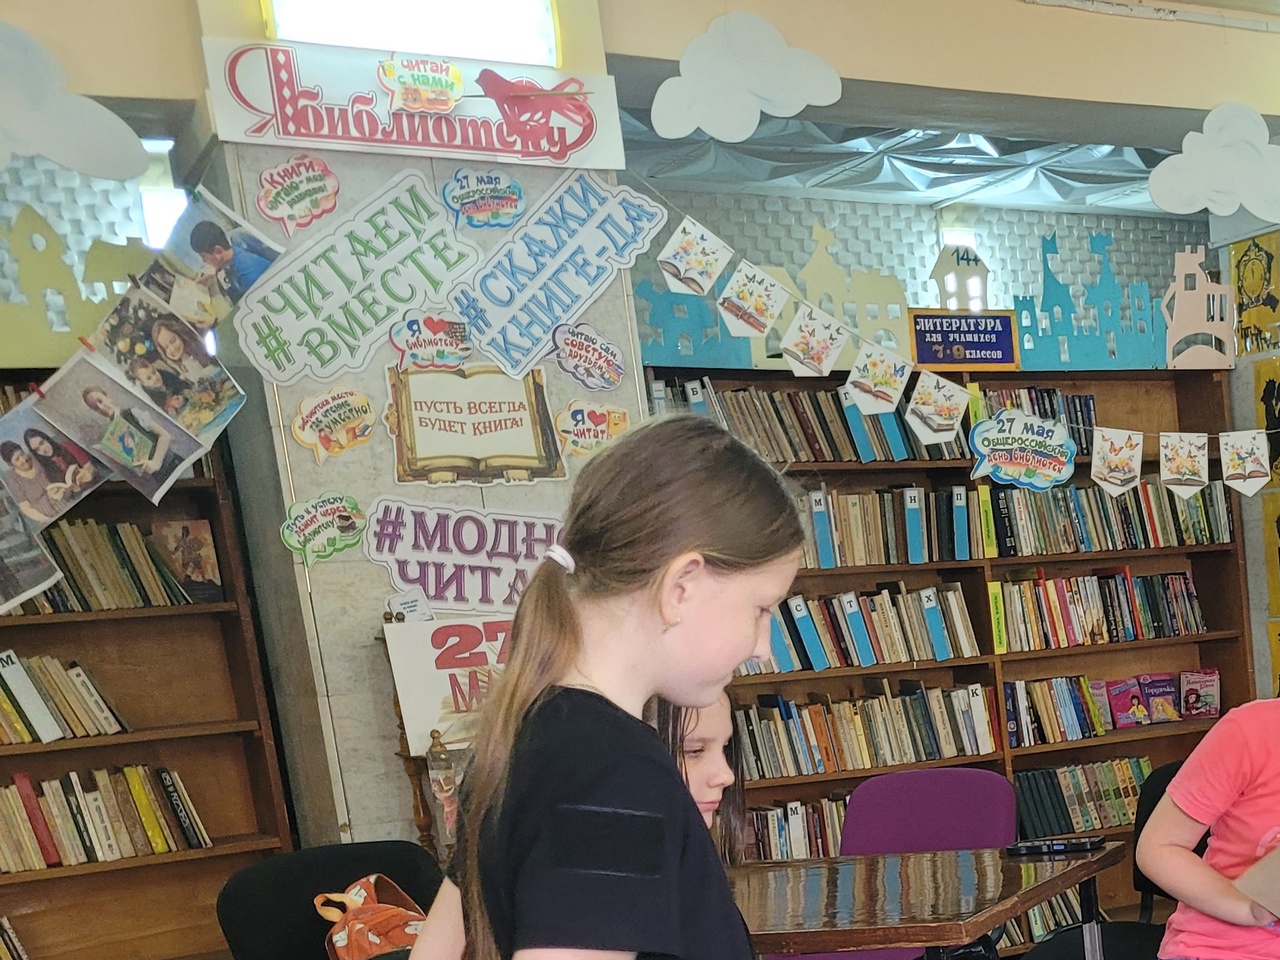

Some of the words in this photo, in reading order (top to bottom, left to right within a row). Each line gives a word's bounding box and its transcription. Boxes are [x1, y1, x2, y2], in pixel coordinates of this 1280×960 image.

[457, 175, 470, 190] 27
[951, 247, 980, 266] 14+
[297, 229, 471, 369] ВМЕСТЕ
[407, 319, 421, 337] Я
[916, 318, 1003, 331] ЛИТЕРАТУРА
[691, 387, 699, 396] Б
[413, 400, 463, 414] ПУСТЬ
[467, 401, 527, 415] ВСЕГДА
[571, 409, 585, 427] Я
[418, 416, 466, 435] БУДЕТ
[472, 417, 523, 436] КНИГА!
[997, 418, 1016, 435] 27
[814, 498, 823, 507] М
[909, 495, 917, 504] Н
[955, 493, 963, 502] П
[373, 504, 566, 564] #МОДН
[795, 603, 803, 612] С
[847, 600, 854, 608] Т
[0, 655, 16, 668] М
[970, 688, 979, 698] К
[790, 806, 799, 815] М
